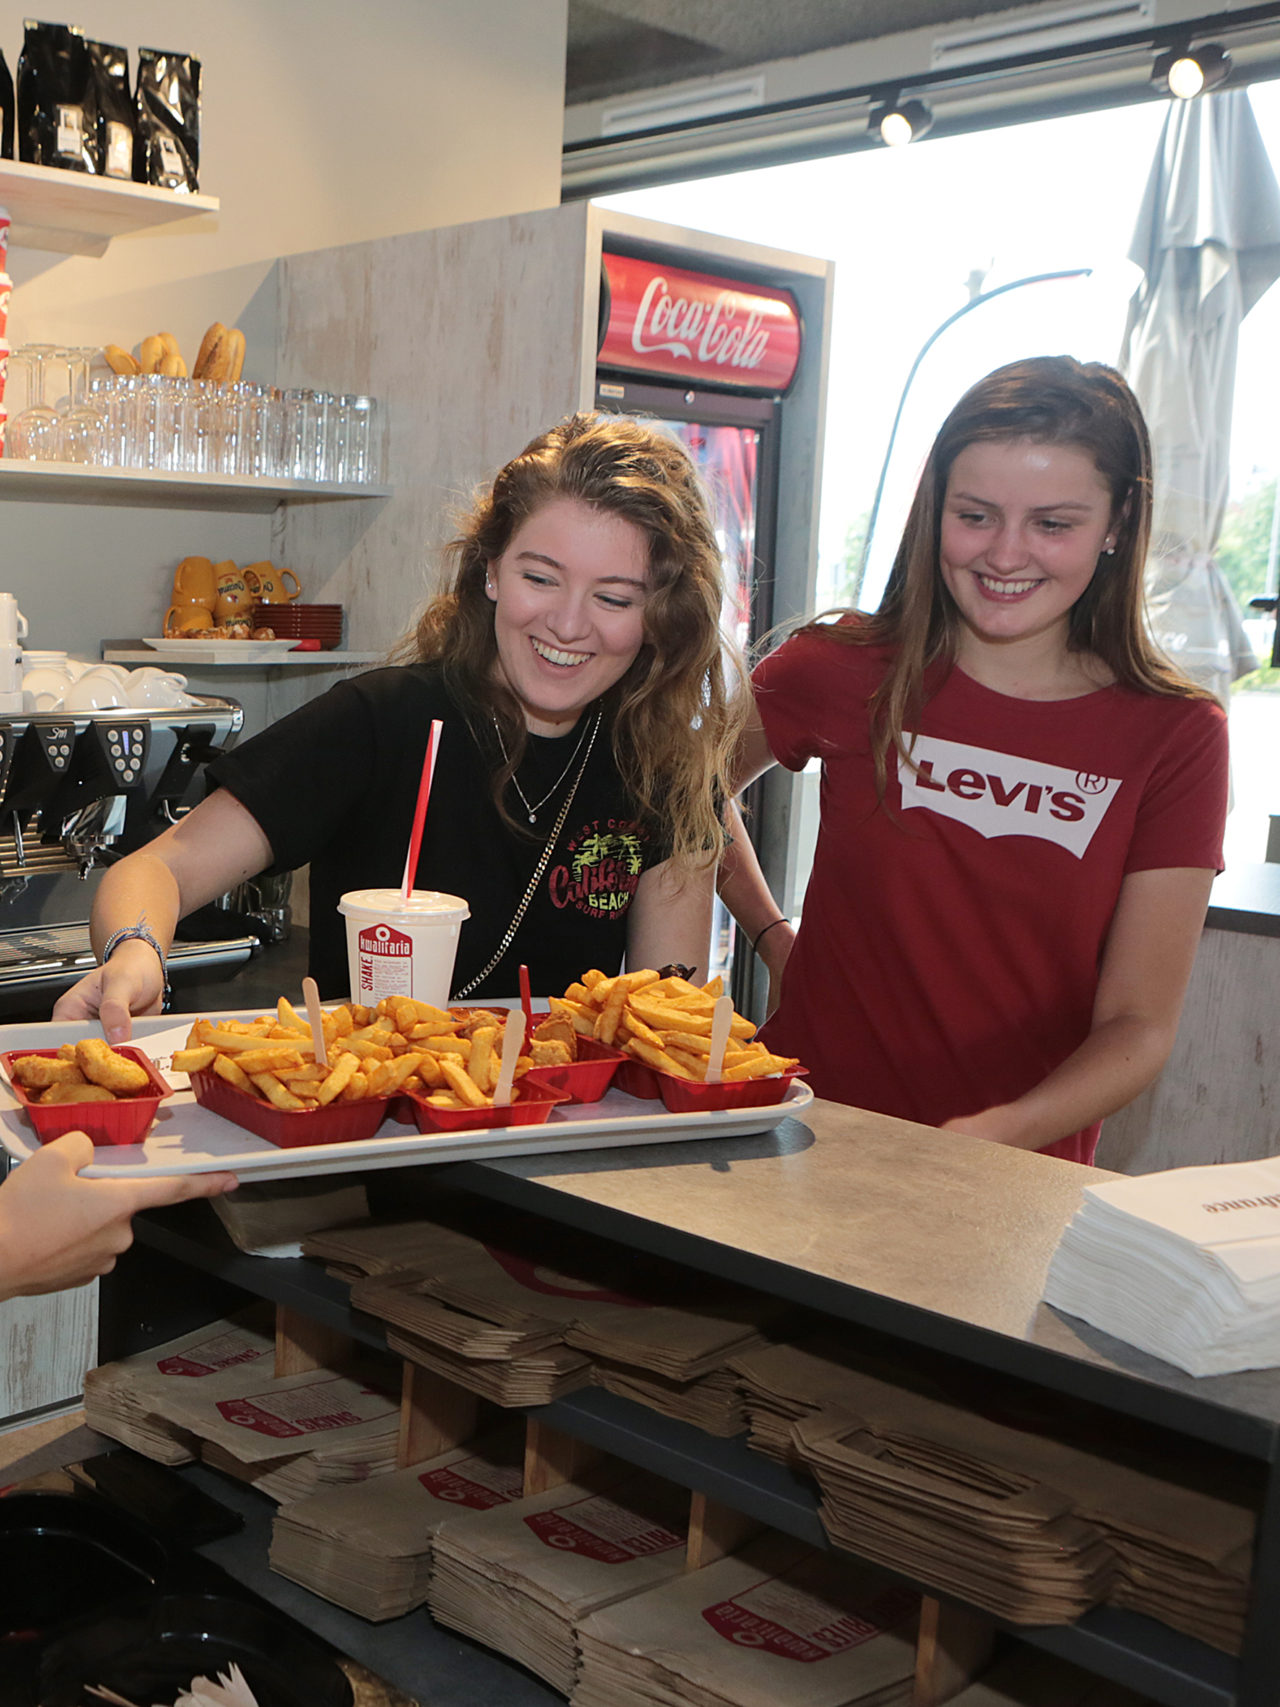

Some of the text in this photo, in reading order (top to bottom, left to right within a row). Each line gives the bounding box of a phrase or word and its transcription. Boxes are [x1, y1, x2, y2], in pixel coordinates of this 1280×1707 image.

[576, 901, 606, 918] SURF
[588, 892, 629, 911] BEACH
[359, 934, 410, 955] kwalitaria
